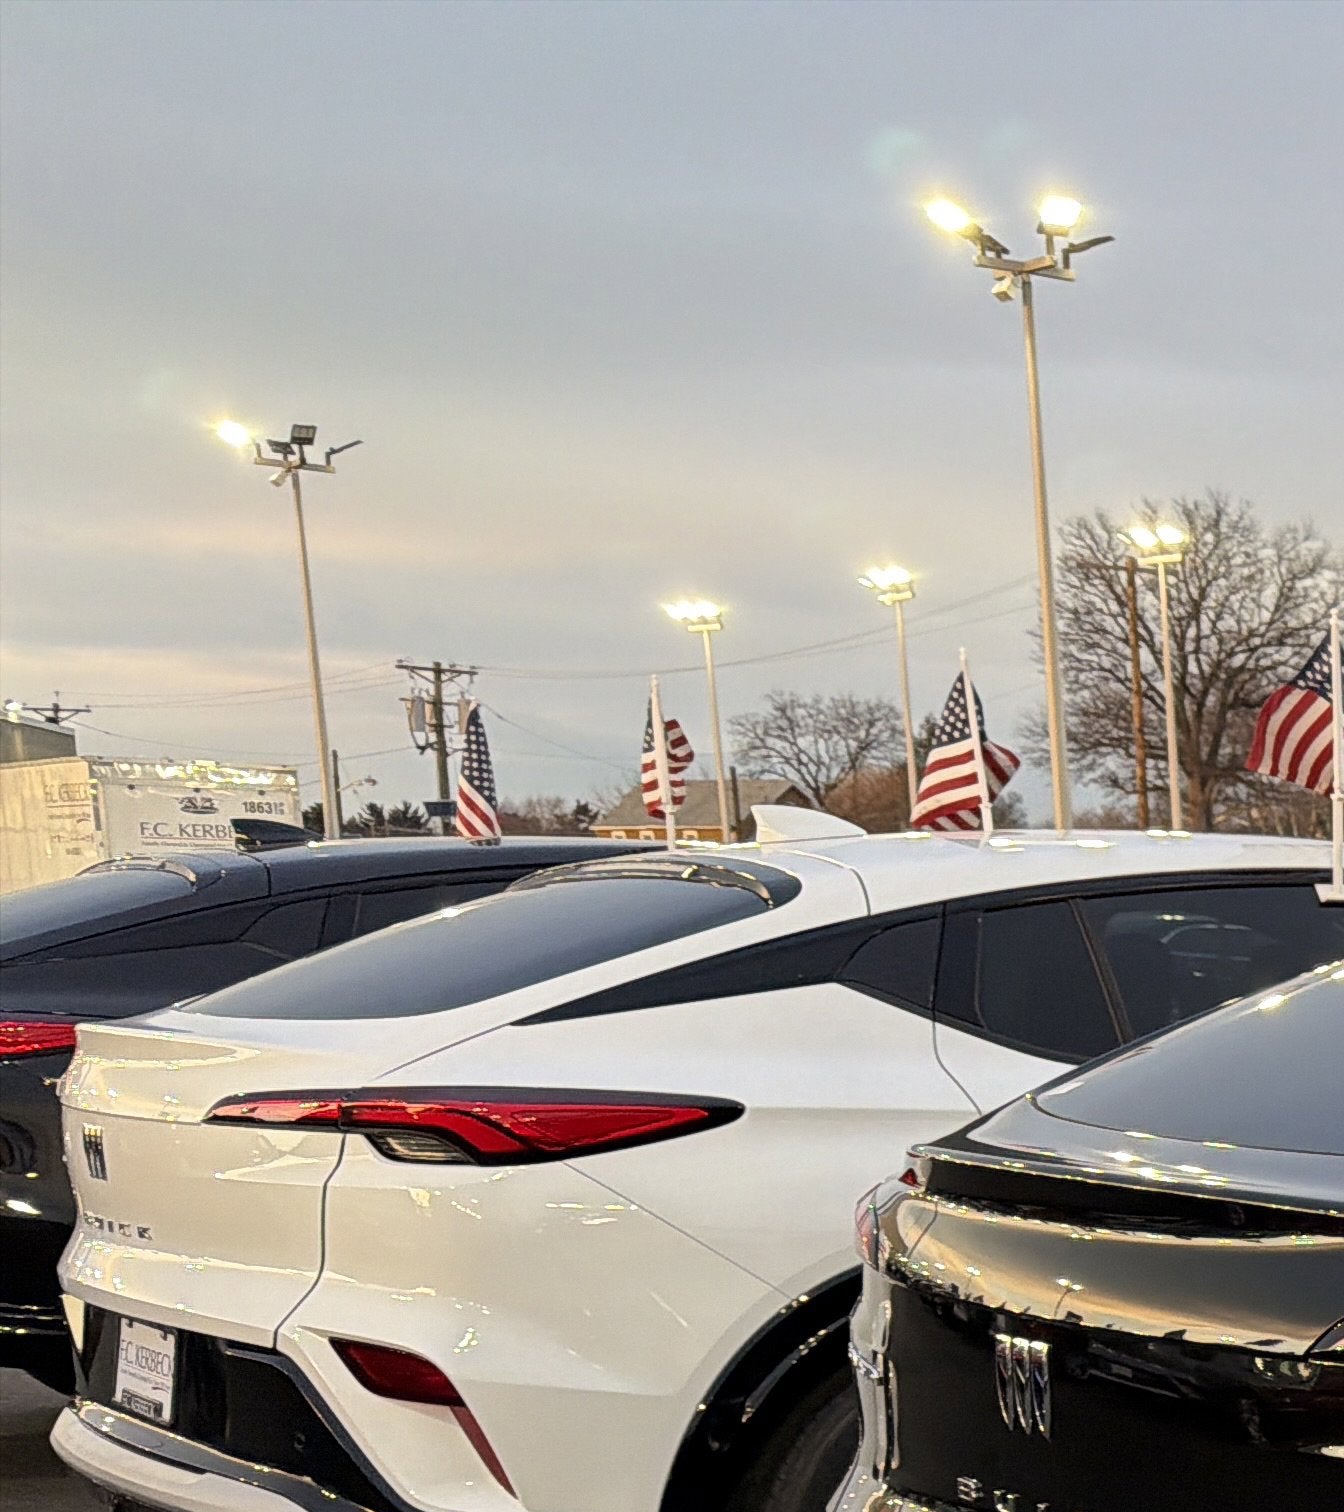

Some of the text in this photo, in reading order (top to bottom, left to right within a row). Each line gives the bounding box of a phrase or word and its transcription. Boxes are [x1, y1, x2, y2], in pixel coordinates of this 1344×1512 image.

[140, 822, 235, 839] F.C. KERBE
[84, 1211, 153, 1241] UICK
